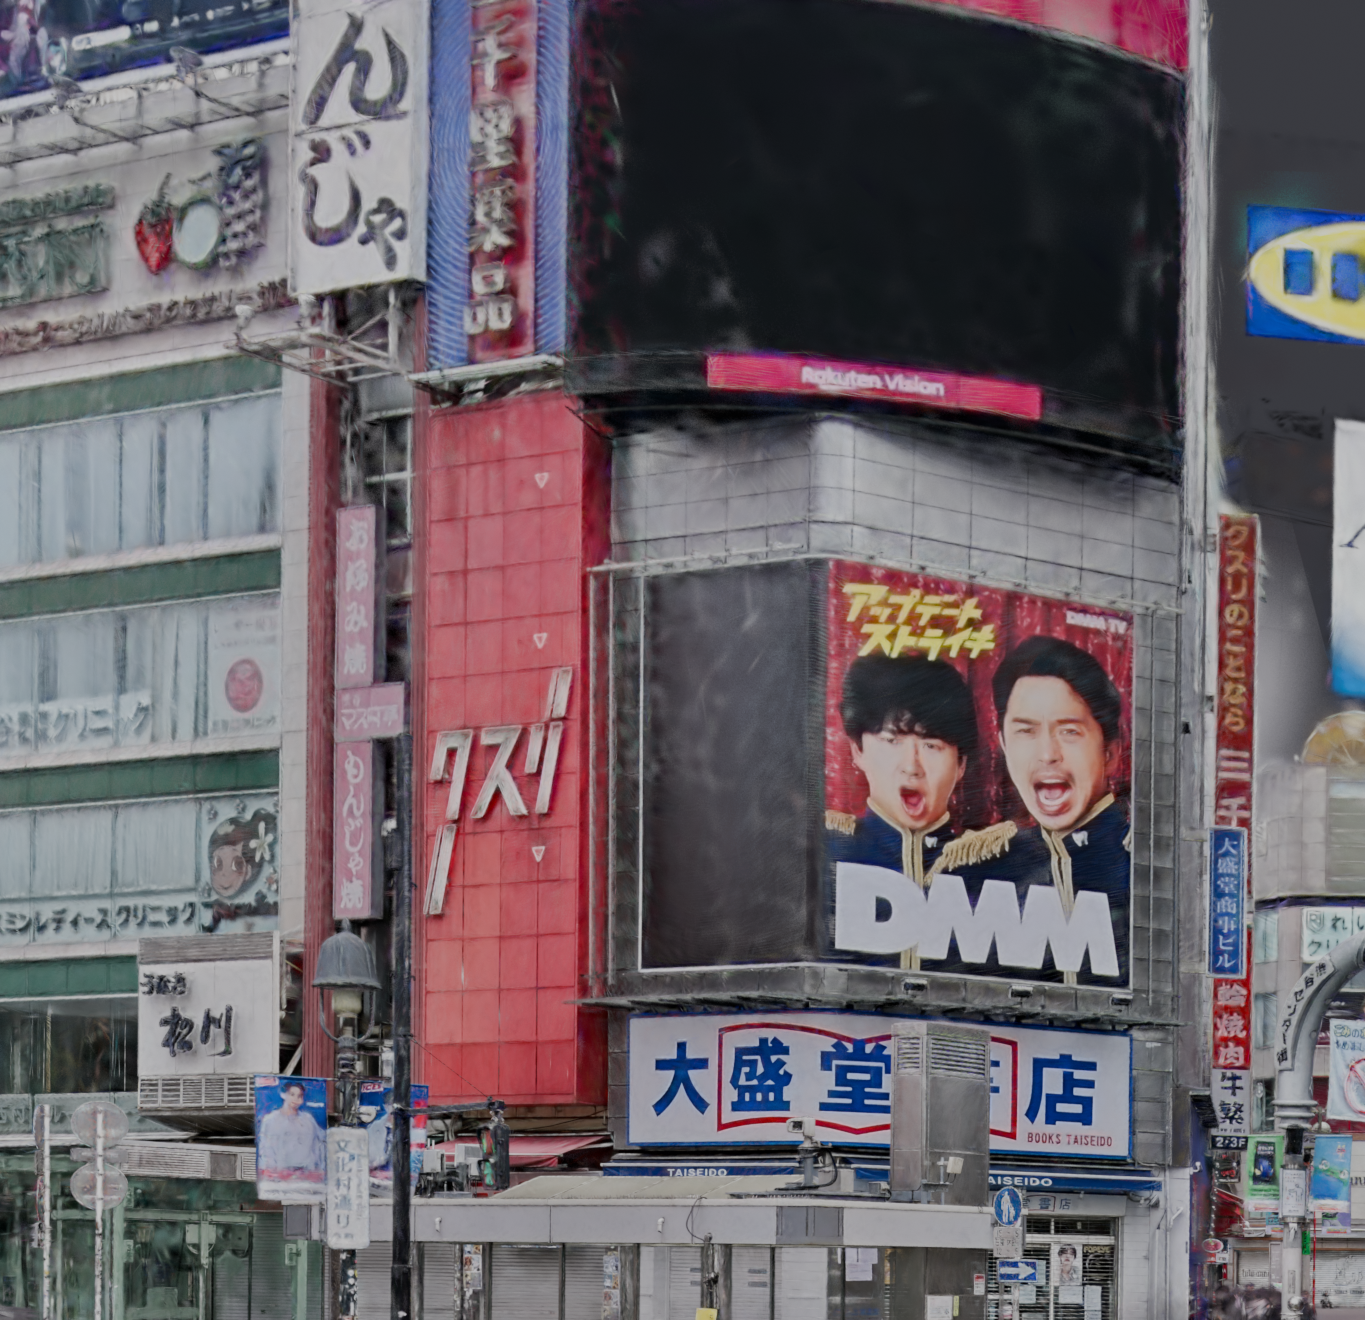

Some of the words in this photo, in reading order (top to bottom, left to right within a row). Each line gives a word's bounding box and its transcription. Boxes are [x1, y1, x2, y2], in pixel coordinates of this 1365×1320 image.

[802, 366, 882, 391] Rakuten
[884, 372, 945, 397] Vision
[842, 584, 982, 628] アップデート
[857, 623, 996, 661] ストライキ
[835, 861, 1120, 978] DMM
[1216, 836, 1239, 969] 大盛堂商事ビル
[1277, 962, 1327, 1065] 渋谷センター街
[652, 1034, 1098, 1128] 大盛堂店
[1027, 1132, 1062, 1145] BOOKS
[1066, 1134, 1113, 1148] TAISEIDO
[667, 1168, 729, 1178] TAISEIDO
